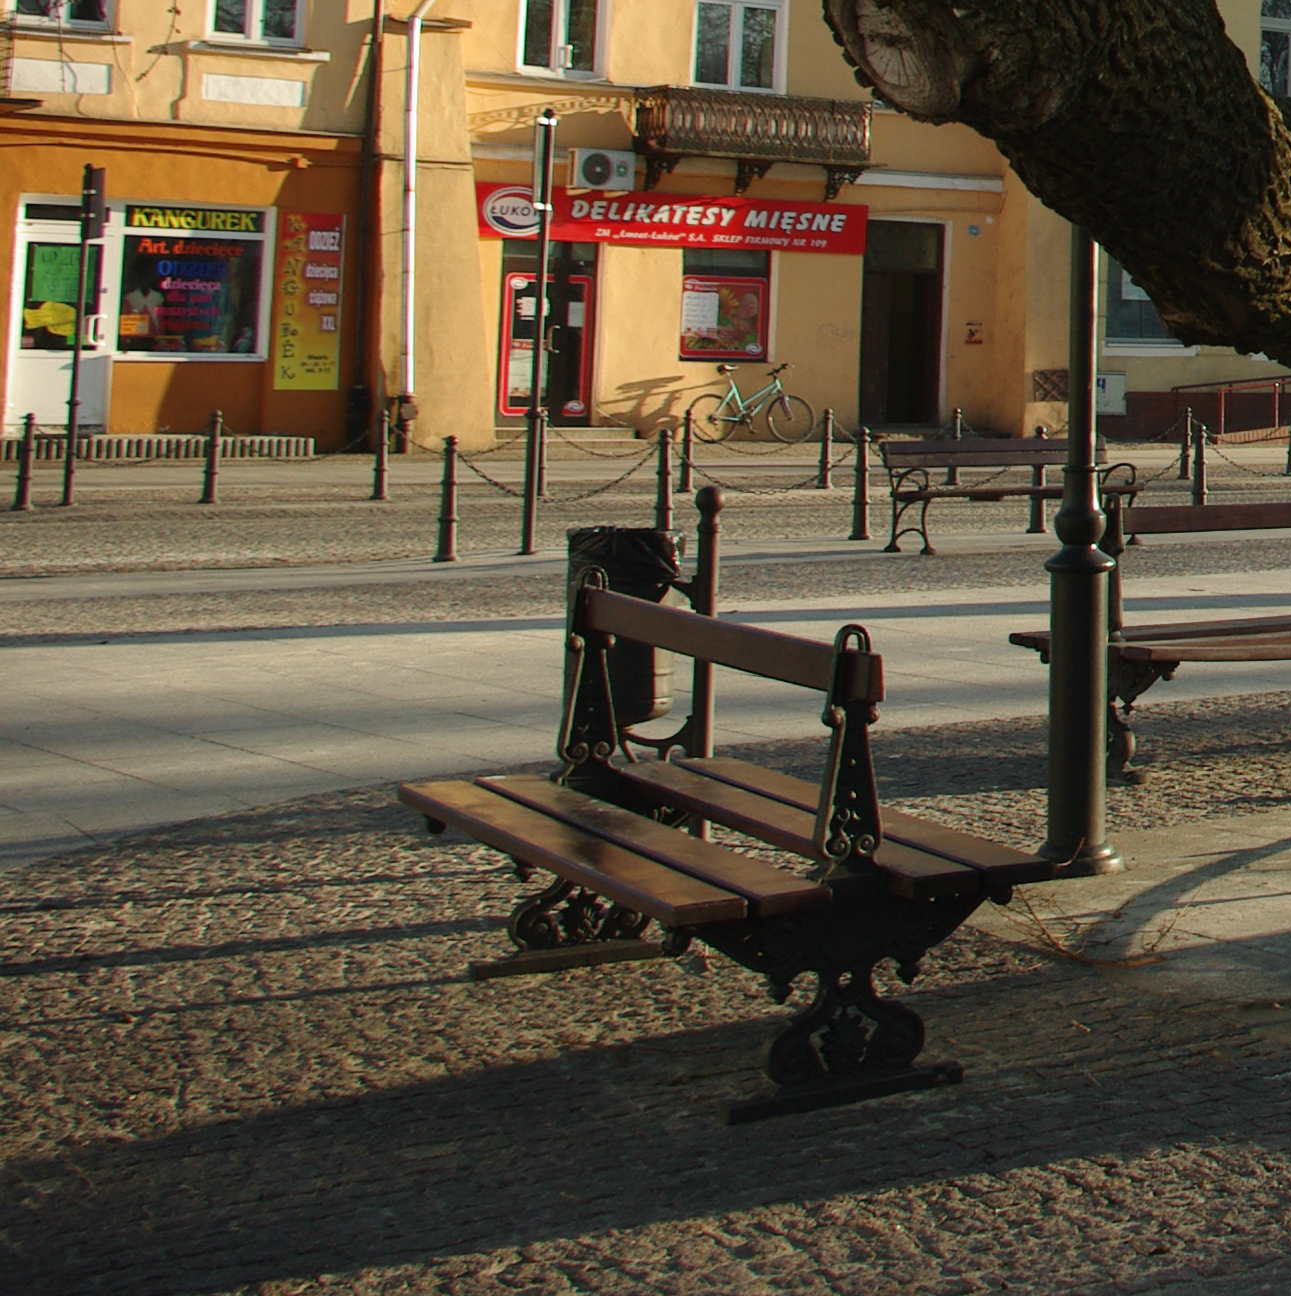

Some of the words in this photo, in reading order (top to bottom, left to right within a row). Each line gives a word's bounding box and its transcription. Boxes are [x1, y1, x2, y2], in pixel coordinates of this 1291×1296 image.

[132, 208, 257, 230] KANGUREK
[571, 200, 735, 226] DELIKATESY
[744, 210, 848, 234] MIĘSNE
[712, 234, 743, 244] SKLEP
